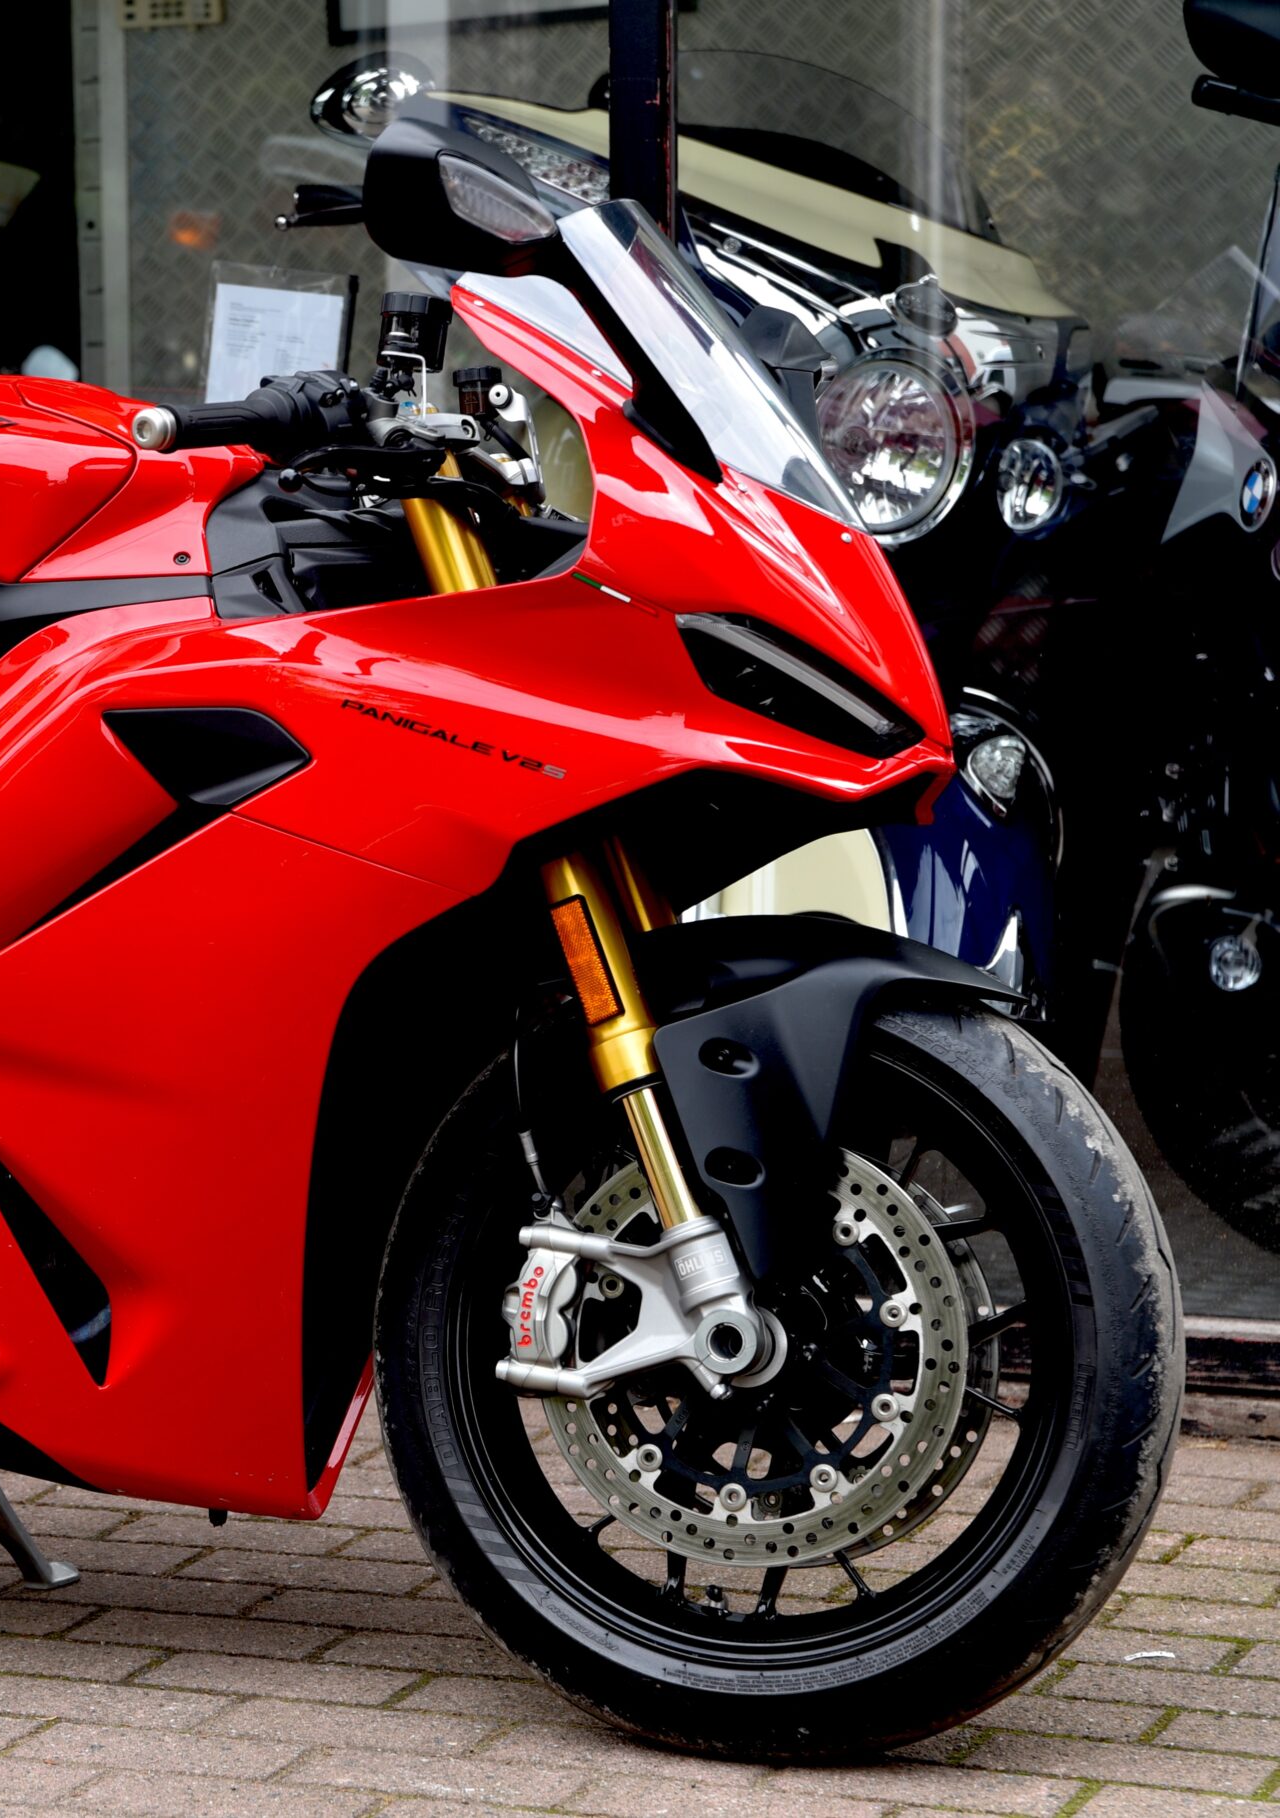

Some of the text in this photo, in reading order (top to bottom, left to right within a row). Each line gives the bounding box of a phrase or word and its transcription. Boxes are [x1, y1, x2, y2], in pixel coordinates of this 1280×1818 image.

[341, 699, 567, 780] PANIGALE V2S
[517, 1266, 544, 1347] brembo
[423, 1325, 459, 1467] DIABLO
